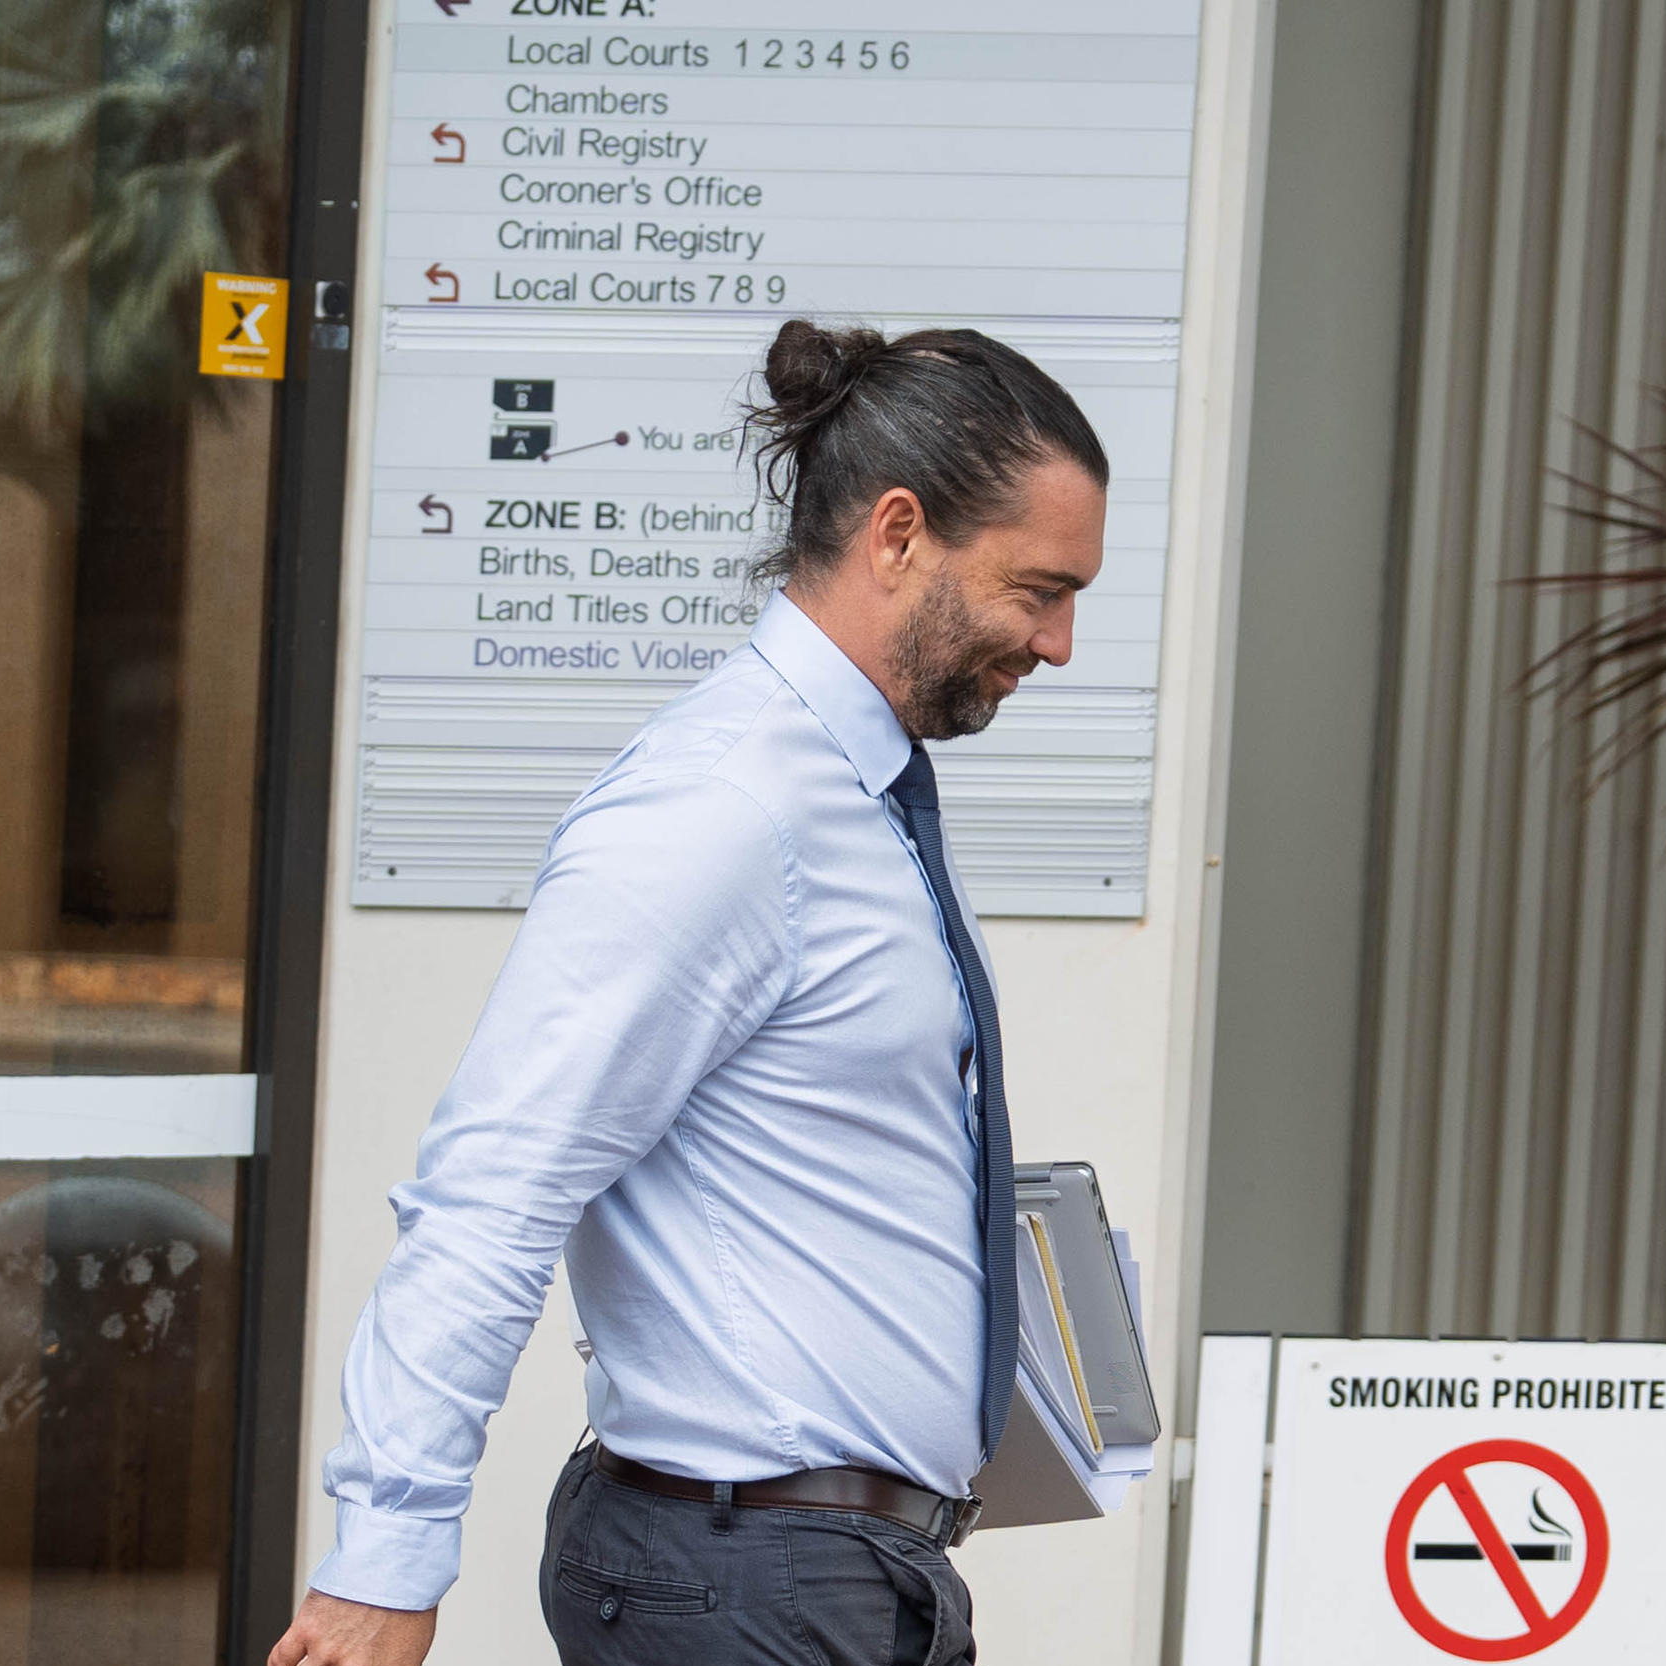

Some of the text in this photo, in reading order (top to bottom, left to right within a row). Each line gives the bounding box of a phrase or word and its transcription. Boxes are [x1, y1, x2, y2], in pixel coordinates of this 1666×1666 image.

[511, 0, 656, 17] ZONE A:
[508, 35, 909, 70] Local Courts 1 2 3 4 5 6
[506, 84, 668, 115] Chambers
[502, 126, 707, 166] Civil Registry
[500, 173, 762, 207] Coroner's Office
[498, 220, 764, 261] Criminal Registry
[217, 278, 277, 295] WARNING
[495, 271, 785, 304] Local Courts 7 8 9
[516, 392, 529, 408] B
[512, 439, 528, 455] A
[638, 426, 683, 451] You
[694, 432, 734, 452] are
[485, 500, 581, 529] ZONE
[595, 502, 625, 530] B:
[641, 503, 753, 538] (behind
[480, 546, 750, 580] Births, Deaths an
[477, 593, 757, 626] Land Titles Office
[474, 638, 727, 670] Domestic Violen
[1330, 1377, 1478, 1408] SMOKING
